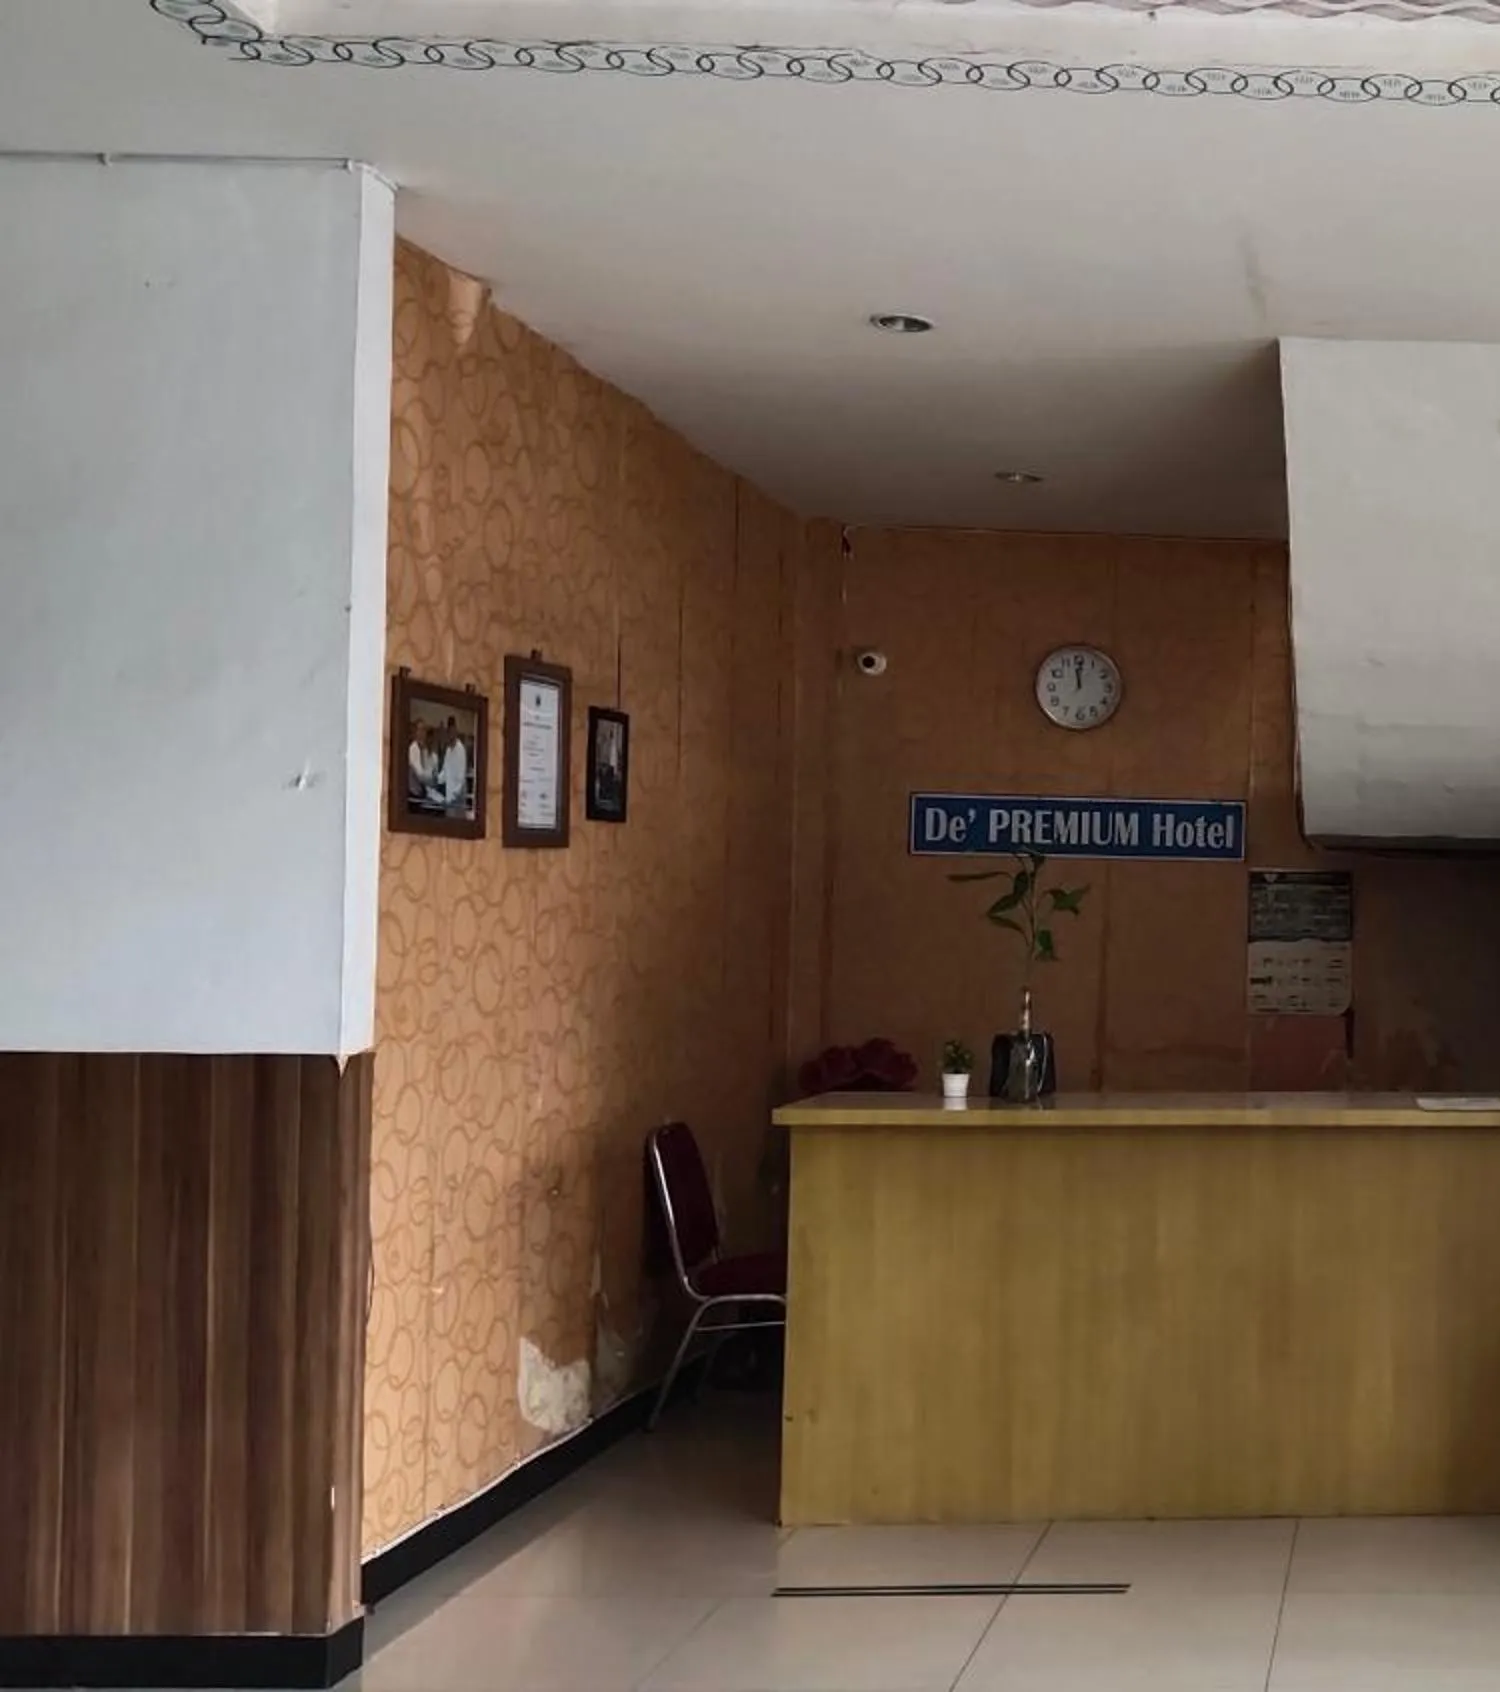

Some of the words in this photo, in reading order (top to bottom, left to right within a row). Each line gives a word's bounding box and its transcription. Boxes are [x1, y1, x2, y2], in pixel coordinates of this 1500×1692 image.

[924, 807, 976, 843] De'
[988, 808, 1139, 847] PREMIUM
[1153, 813, 1235, 849] Hotel
